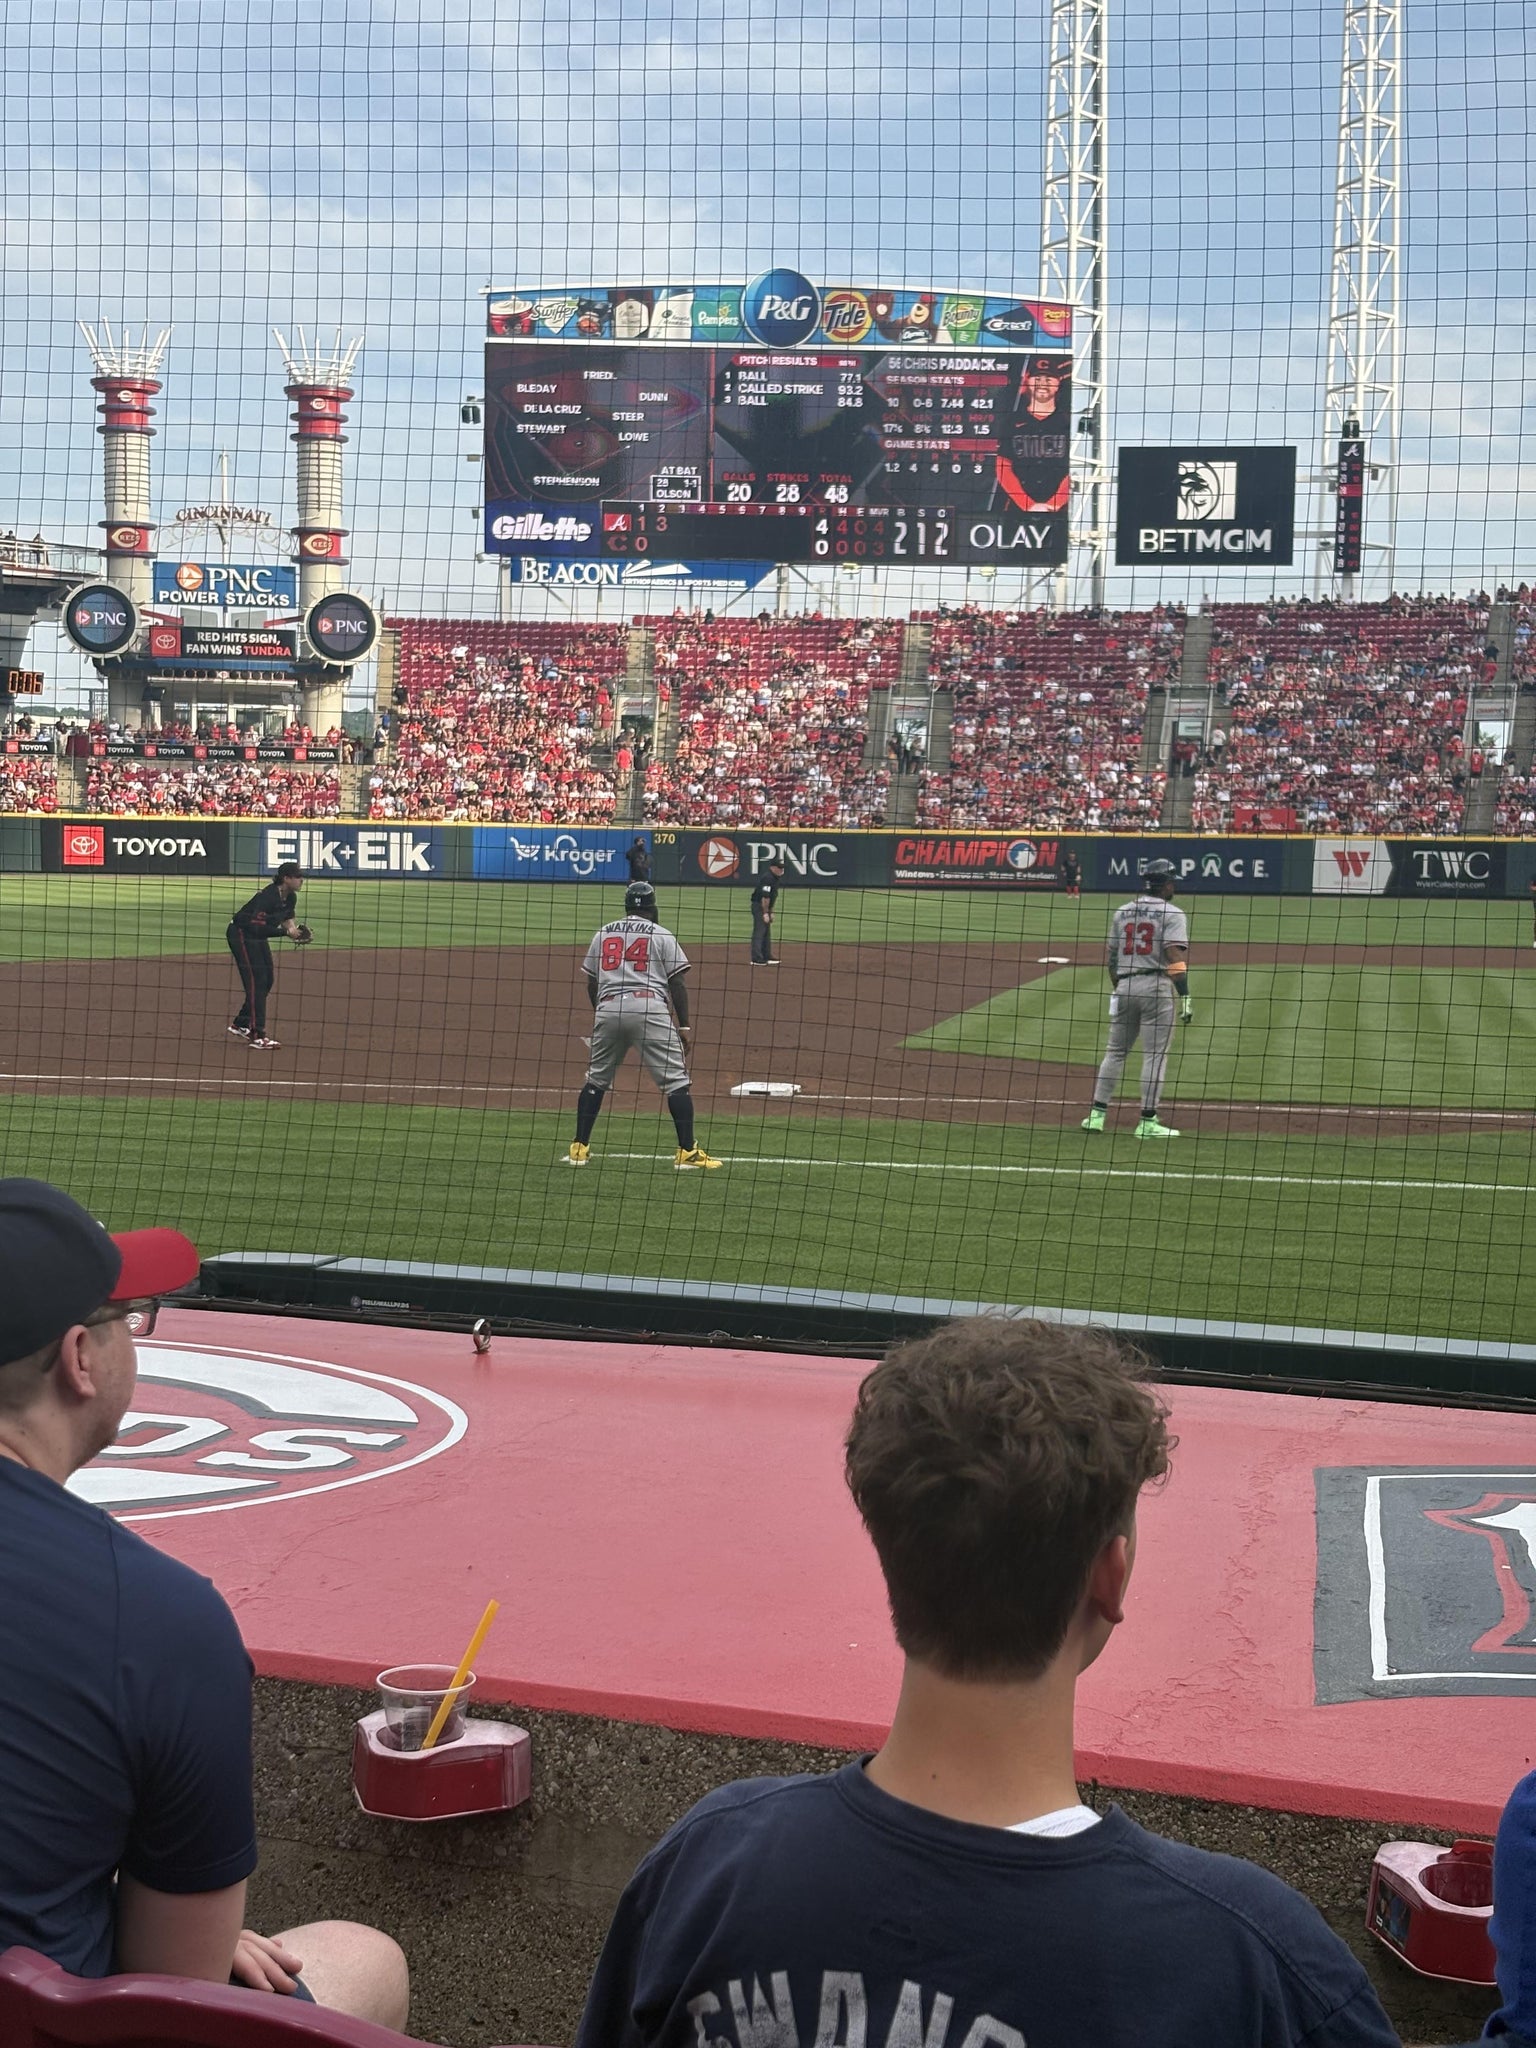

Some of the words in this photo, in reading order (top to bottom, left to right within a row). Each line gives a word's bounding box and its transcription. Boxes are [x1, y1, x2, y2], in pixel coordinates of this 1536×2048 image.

[531, 302, 578, 323] Swiffer
[758, 294, 812, 321] P&G
[698, 311, 739, 327] Pampers
[823, 301, 866, 334] Tide
[986, 318, 1031, 331] Crest
[772, 356, 817, 366] RESULTS
[904, 358, 938, 370] CHRIS
[940, 358, 996, 371] PADDACK
[738, 371, 768, 381] BALL
[886, 376, 927, 385] SEASON
[930, 376, 965, 385] STATS
[517, 384, 557, 393] BLEDAY
[738, 384, 782, 394] CALLED
[784, 385, 823, 395] STRIKE
[838, 385, 863, 395] 93.2
[738, 395, 768, 406] BALL
[837, 398, 863, 407] 84.8
[539, 405, 553, 414] LA
[554, 405, 582, 414] CRUZ
[612, 412, 645, 421] STEER
[516, 424, 567, 434] STEWART
[619, 432, 649, 442] LOWE
[885, 440, 915, 449] GAME
[916, 440, 950, 450] STATS
[661, 466, 675, 474] AT
[675, 466, 697, 475] BAT
[885, 463, 900, 472] 1.2
[952, 464, 961, 473] 0
[657, 478, 668, 487] 28
[767, 473, 809, 482] STRIKES
[820, 475, 853, 483] TOTAL
[656, 489, 692, 498] OLSON
[727, 483, 752, 502] 20
[776, 484, 800, 503] 28
[824, 485, 849, 503] 48
[176, 505, 272, 524] CINCINNATI
[492, 513, 591, 541] Gillette
[637, 518, 645, 531] 1
[656, 518, 668, 532] 3
[816, 519, 829, 534] 4
[836, 520, 848, 535] 4
[854, 520, 867, 535] 0
[872, 520, 885, 535] 4
[894, 522, 907, 555] 2
[916, 522, 926, 555] 1
[935, 522, 949, 555] 2
[970, 524, 1050, 549] OLAY
[1139, 529, 1272, 553] BETMGM
[634, 536, 648, 551] 0
[815, 539, 828, 555] 0
[836, 540, 849, 555] 0
[854, 540, 867, 555] 0
[520, 557, 620, 585] BEACON
[207, 568, 272, 593] PNC
[159, 591, 219, 604] POWER
[225, 592, 290, 607] STACKS
[93, 612, 127, 626] PNC
[336, 620, 367, 634] PNC
[197, 632, 222, 643] RED
[224, 632, 248, 644] HITS
[249, 633, 281, 646] SIGN,
[186, 643, 212, 654] FAN
[213, 644, 242, 655] WINS
[244, 645, 292, 656] TUNDRA
[8, 670, 43, 695] 0:06
[654, 833, 676, 844] 370
[112, 837, 207, 857] TOYOTA
[544, 835, 617, 875] Kroger
[747, 842, 838, 876] PNC
[1108, 856, 1265, 878] MEPACE
[1413, 851, 1490, 880] TWC
[895, 870, 934, 879] Windows
[605, 922, 656, 934] WATKINS
[1122, 922, 1155, 955] 13
[601, 937, 649, 972] 84
